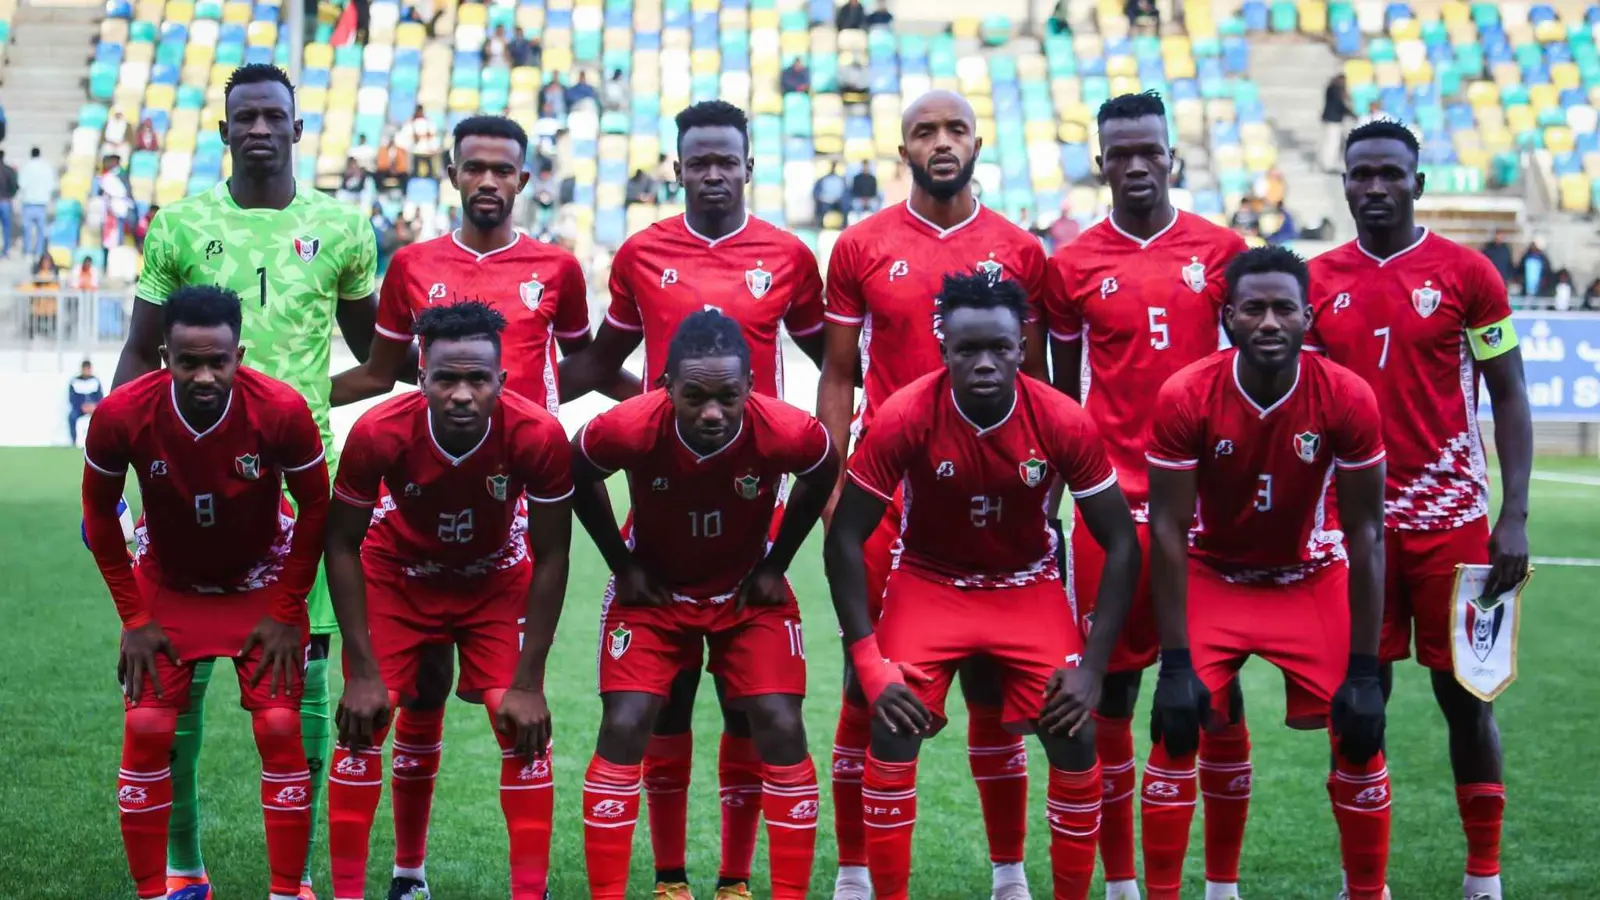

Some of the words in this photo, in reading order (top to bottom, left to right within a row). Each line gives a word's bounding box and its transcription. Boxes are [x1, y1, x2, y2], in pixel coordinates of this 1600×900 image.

[257, 267, 267, 308] 1
[1147, 306, 1170, 350] 5
[1373, 326, 1390, 370] 7
[1573, 375, 1599, 408] S
[195, 493, 215, 527] 8
[1254, 474, 1272, 512] 3
[437, 508, 474, 543] 22
[688, 510, 721, 538] 10
[971, 496, 1002, 527] 24
